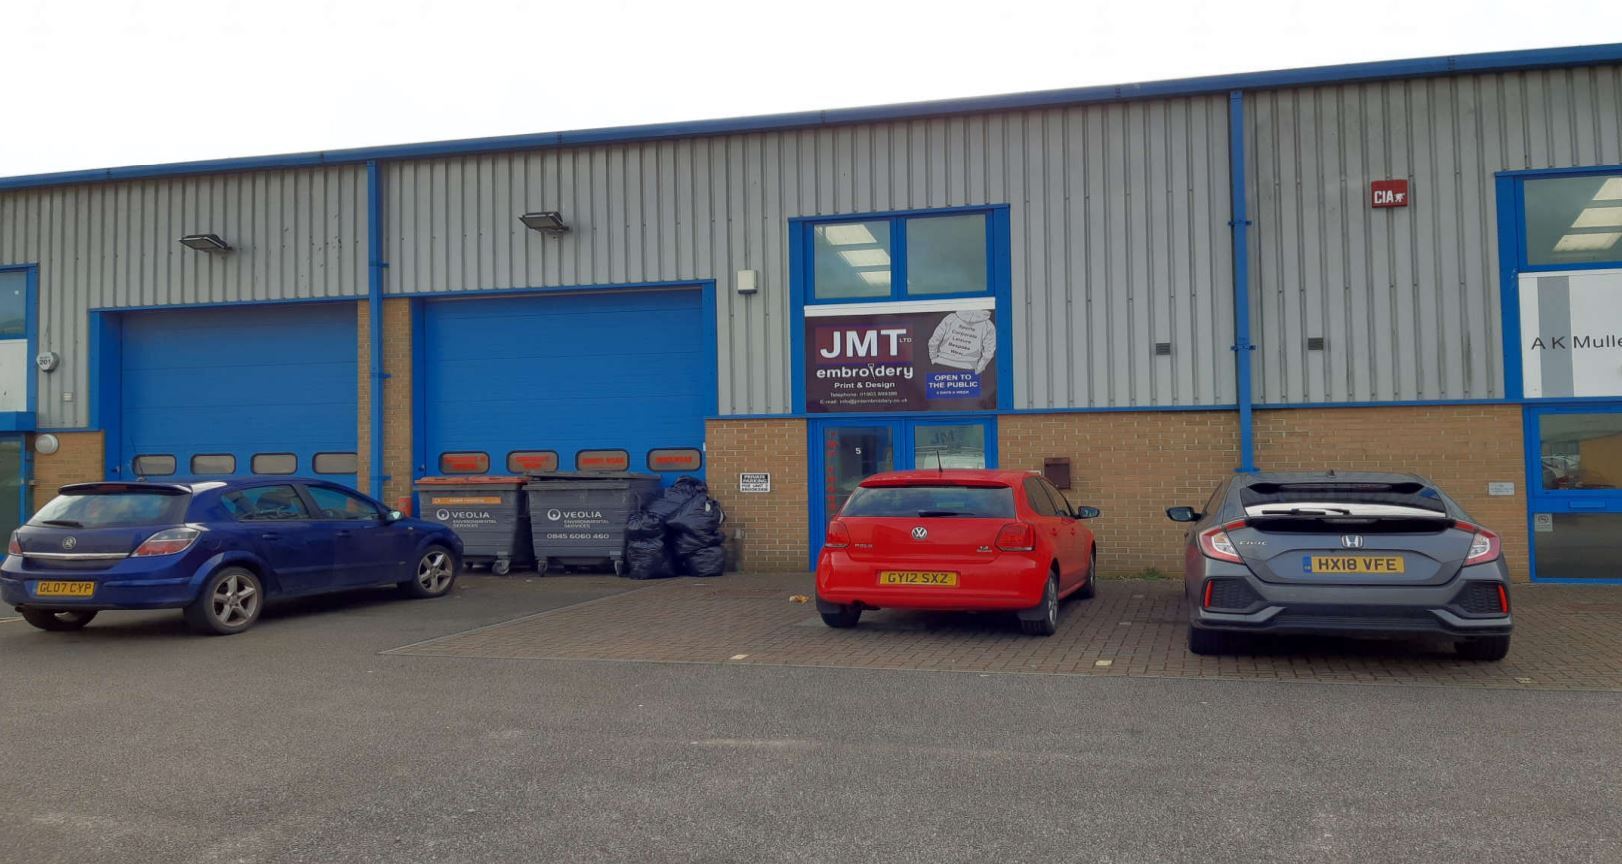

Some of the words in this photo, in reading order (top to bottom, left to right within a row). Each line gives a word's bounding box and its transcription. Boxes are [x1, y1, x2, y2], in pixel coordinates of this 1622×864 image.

[1375, 190, 1394, 203] CIA
[820, 328, 906, 358] JMT
[1531, 337, 1546, 350] A
[1552, 336, 1566, 349] K
[816, 363, 913, 379] embroidery
[865, 381, 895, 389] Design
[855, 447, 862, 455] 5
[1318, 559, 1357, 571] HX18
[1362, 559, 1397, 571] VFE
[888, 573, 918, 583] GY12
[921, 573, 948, 584] SXZ
[40, 583, 67, 593] GL07
[69, 583, 92, 593] CYP
